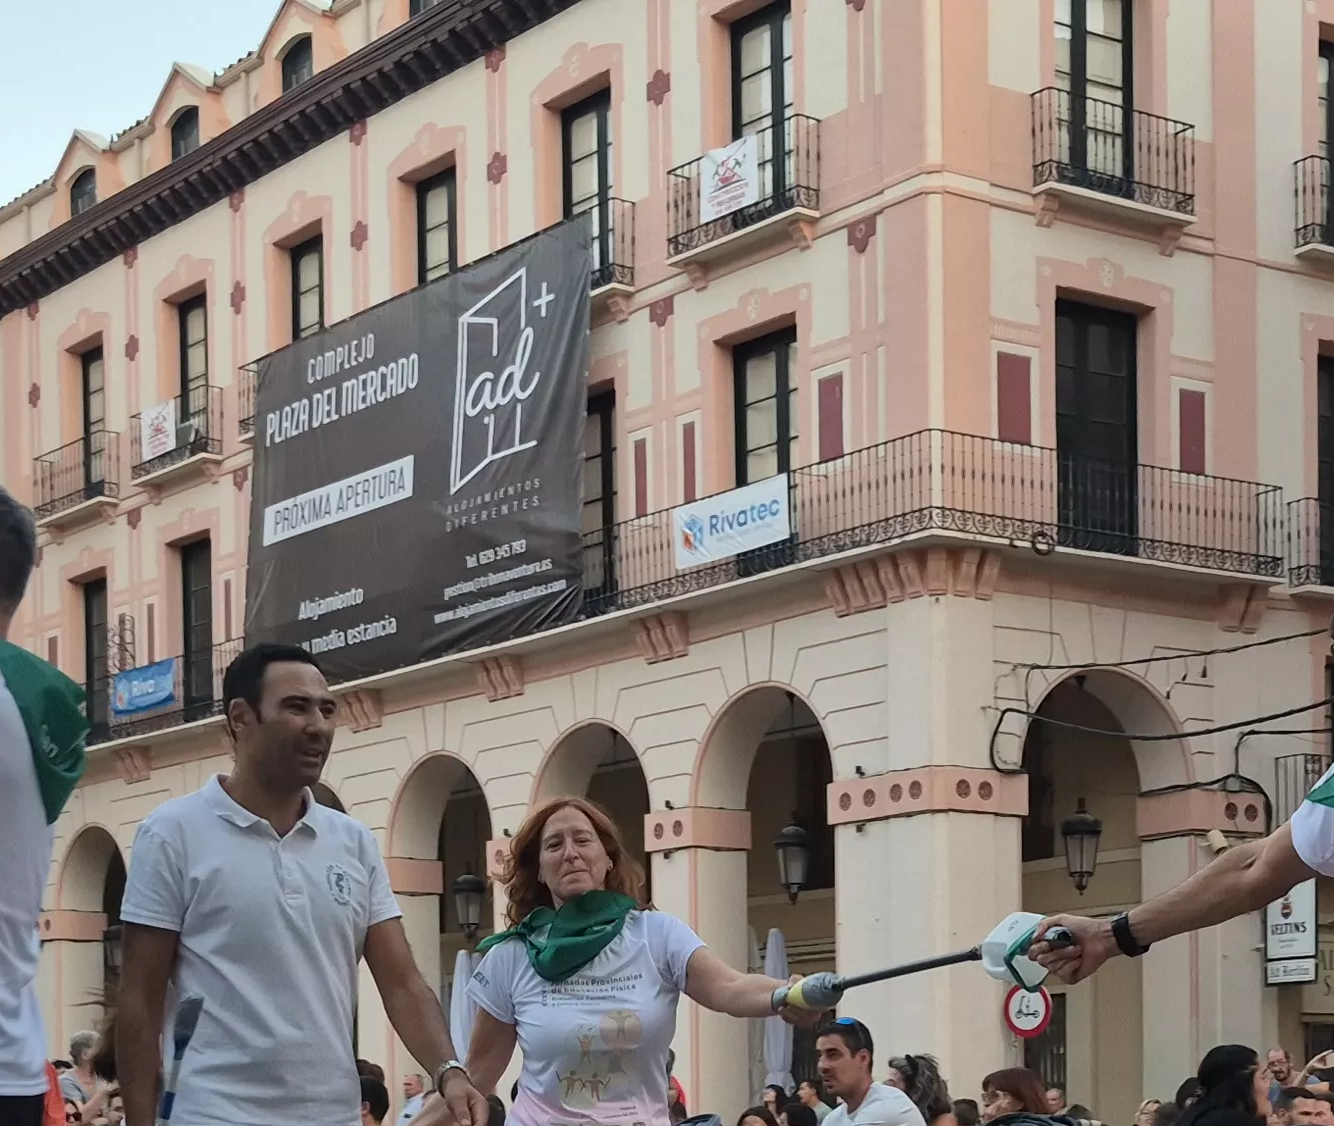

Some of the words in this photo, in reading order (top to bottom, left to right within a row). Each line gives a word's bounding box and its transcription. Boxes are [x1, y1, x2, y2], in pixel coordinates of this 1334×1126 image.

[307, 333, 375, 384] COMPLEJO
[266, 398, 309, 447] PLAZA
[311, 386, 340, 429] DEL
[341, 352, 419, 417] MERCADO
[273, 493, 331, 536] PRÓXIMA
[335, 465, 406, 514] APERTURA
[445, 495, 540, 533] DIFERENTES
[446, 478, 540, 515] ALOJAMIENTOS
[708, 499, 780, 536] Rivatec
[297, 587, 364, 621] Alojamiento
[311, 629, 346, 655] media
[347, 615, 397, 645] estancia
[591, 973, 643, 986] Provinciales
